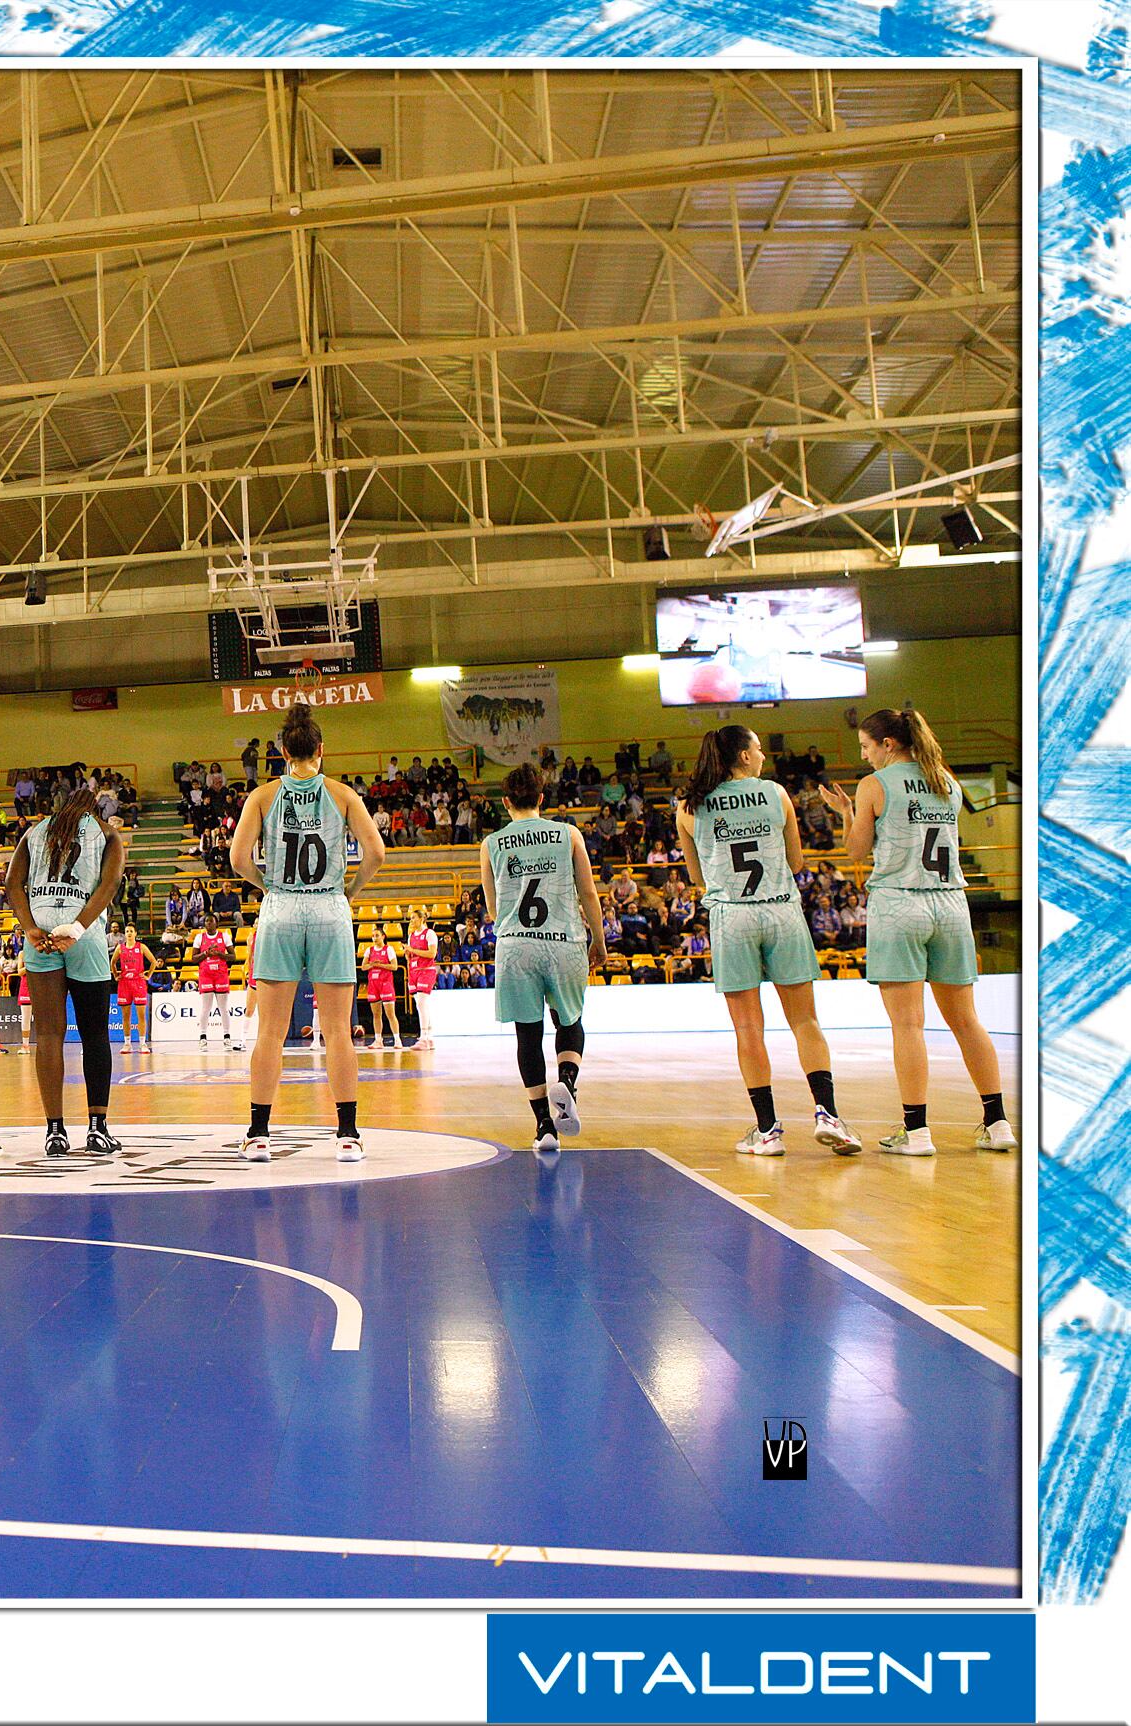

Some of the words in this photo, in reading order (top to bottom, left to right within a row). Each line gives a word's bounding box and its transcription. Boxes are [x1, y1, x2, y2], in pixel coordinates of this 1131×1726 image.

[254, 669, 272, 677] FALTAS
[322, 665, 340, 674] FALTAS
[231, 687, 269, 713] LA
[271, 681, 374, 710] GACETA
[706, 791, 768, 813] MEDINA
[498, 829, 562, 852] FERNÁNDEZ
[282, 832, 327, 885] 10
[922, 827, 950, 883] 4
[730, 840, 764, 898] 5
[518, 877, 549, 928] 6
[180, 1007, 197, 1018] EL
